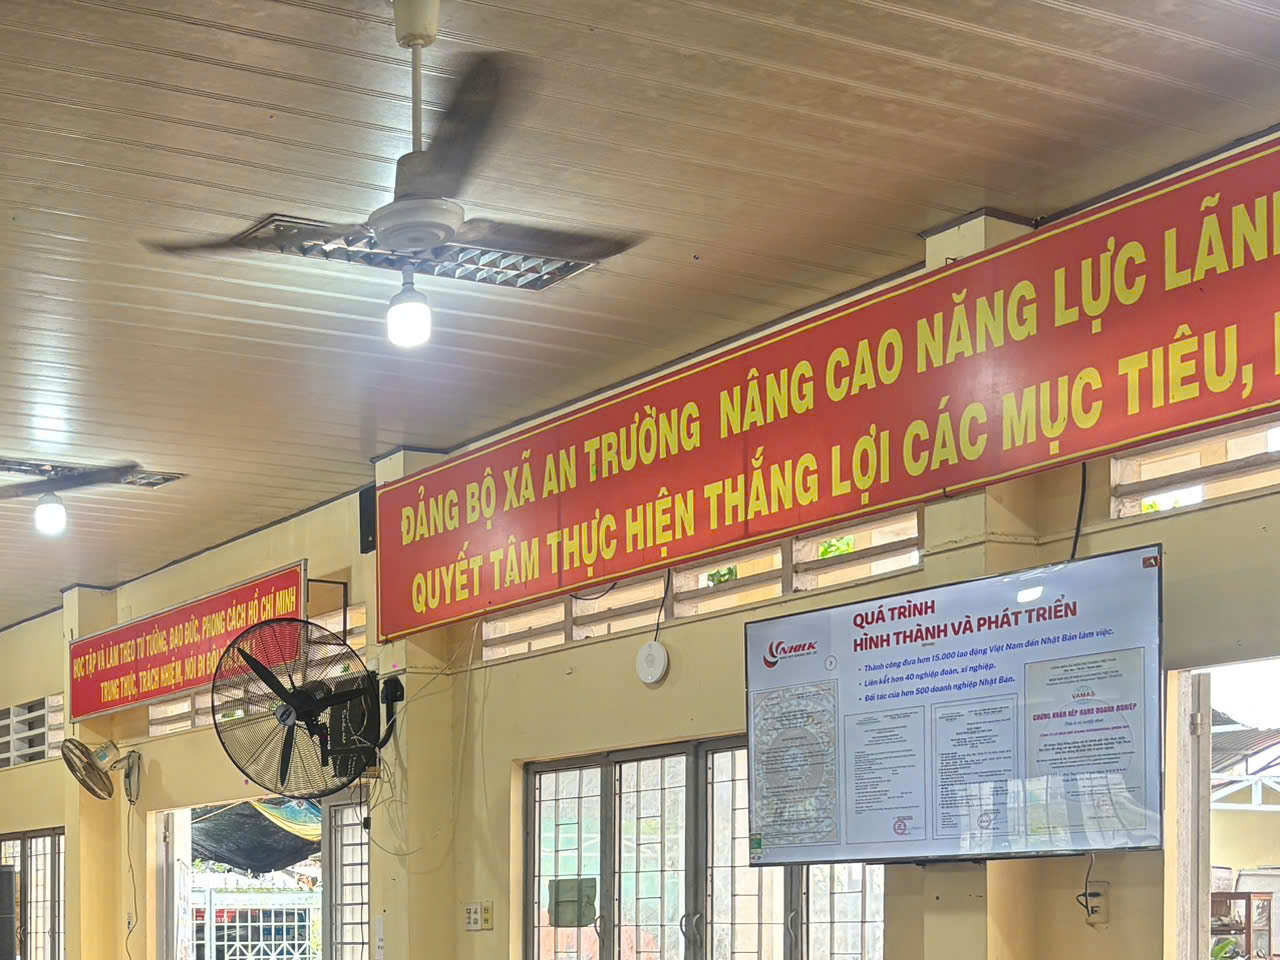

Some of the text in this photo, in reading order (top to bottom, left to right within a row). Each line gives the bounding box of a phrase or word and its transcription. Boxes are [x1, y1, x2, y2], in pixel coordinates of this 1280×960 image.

[401, 192, 1280, 545] ĐẢNG BỘ XÃ AN TRƯỜNG NÂNG CAO NĂNG LỰC LÃN
[412, 541, 484, 615] QUYẾT
[490, 537, 540, 590] TÂM
[546, 509, 617, 577] THỰC
[625, 487, 695, 558] HIỆN
[703, 443, 819, 530] THẮNG
[830, 423, 891, 506] LỢI
[902, 395, 989, 478] CÁC
[1001, 366, 1104, 456] MỤC
[1117, 323, 1254, 416] TIÊU,
[202, 613, 225, 639] PHONG
[226, 603, 247, 632] CÁCH
[248, 588, 259, 625] HỒ
[260, 586, 275, 620] CHÍ
[275, 585, 297, 618] MINH
[853, 600, 936, 630] QUÁ TRÌNH
[853, 594, 1078, 652] HÌNH THÀNH VÀ PHÁT TRIỂN
[864, 662, 884, 673] Thành
[885, 660, 902, 671] công
[902, 656, 916, 667] đưa
[931, 651, 956, 662] 15.000
[956, 651, 968, 660] lao
[969, 646, 988, 658] động
[989, 642, 1004, 653] Việt
[1005, 641, 1024, 650] Nam
[1040, 636, 1060, 647] Nhật
[1078, 630, 1094, 640] làm
[138, 663, 160, 693] TRÁCH
[879, 673, 890, 685] kết
[905, 671, 915, 681] 40
[915, 669, 939, 683] nghiệp
[915, 686, 930, 696] 500
[930, 682, 952, 693] doanh
[953, 678, 977, 692] nghiệp
[979, 676, 997, 687] Nhật
